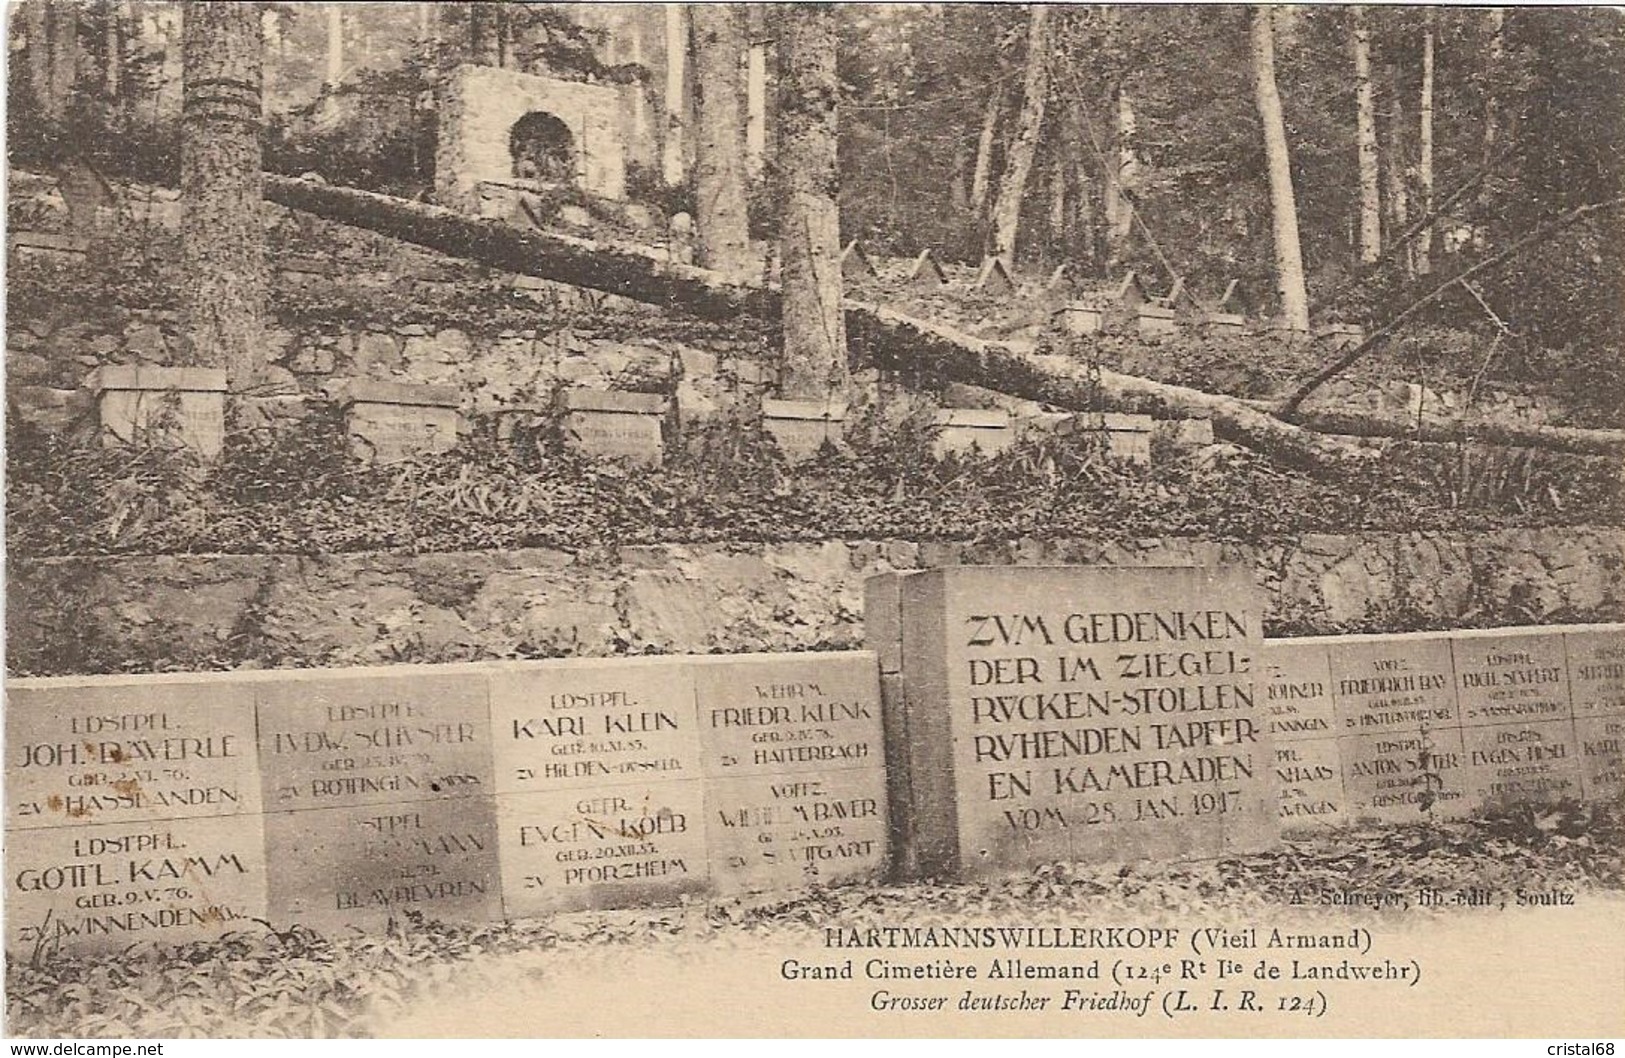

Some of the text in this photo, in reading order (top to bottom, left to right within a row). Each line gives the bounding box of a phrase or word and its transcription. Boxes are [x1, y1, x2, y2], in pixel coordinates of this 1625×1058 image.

[1063, 610, 1248, 645] GEDENKEN
[969, 657, 1043, 687] DER
[1057, 656, 1102, 684] IM
[1340, 674, 1415, 696] FRIEDRICH
[513, 712, 679, 741] KARL KLEIN
[711, 702, 872, 728] FRIEDR. KLENK
[1150, 718, 1260, 750] TAPFER-
[17, 743, 86, 769] JOH.
[988, 753, 1253, 801] EN KAMERADEN
[620, 813, 687, 839] KOLB
[1004, 806, 1069, 831] VOM
[1134, 796, 1185, 822] JAN.
[129, 853, 250, 884] KAMM
[565, 858, 688, 885] PFORZHEIM
